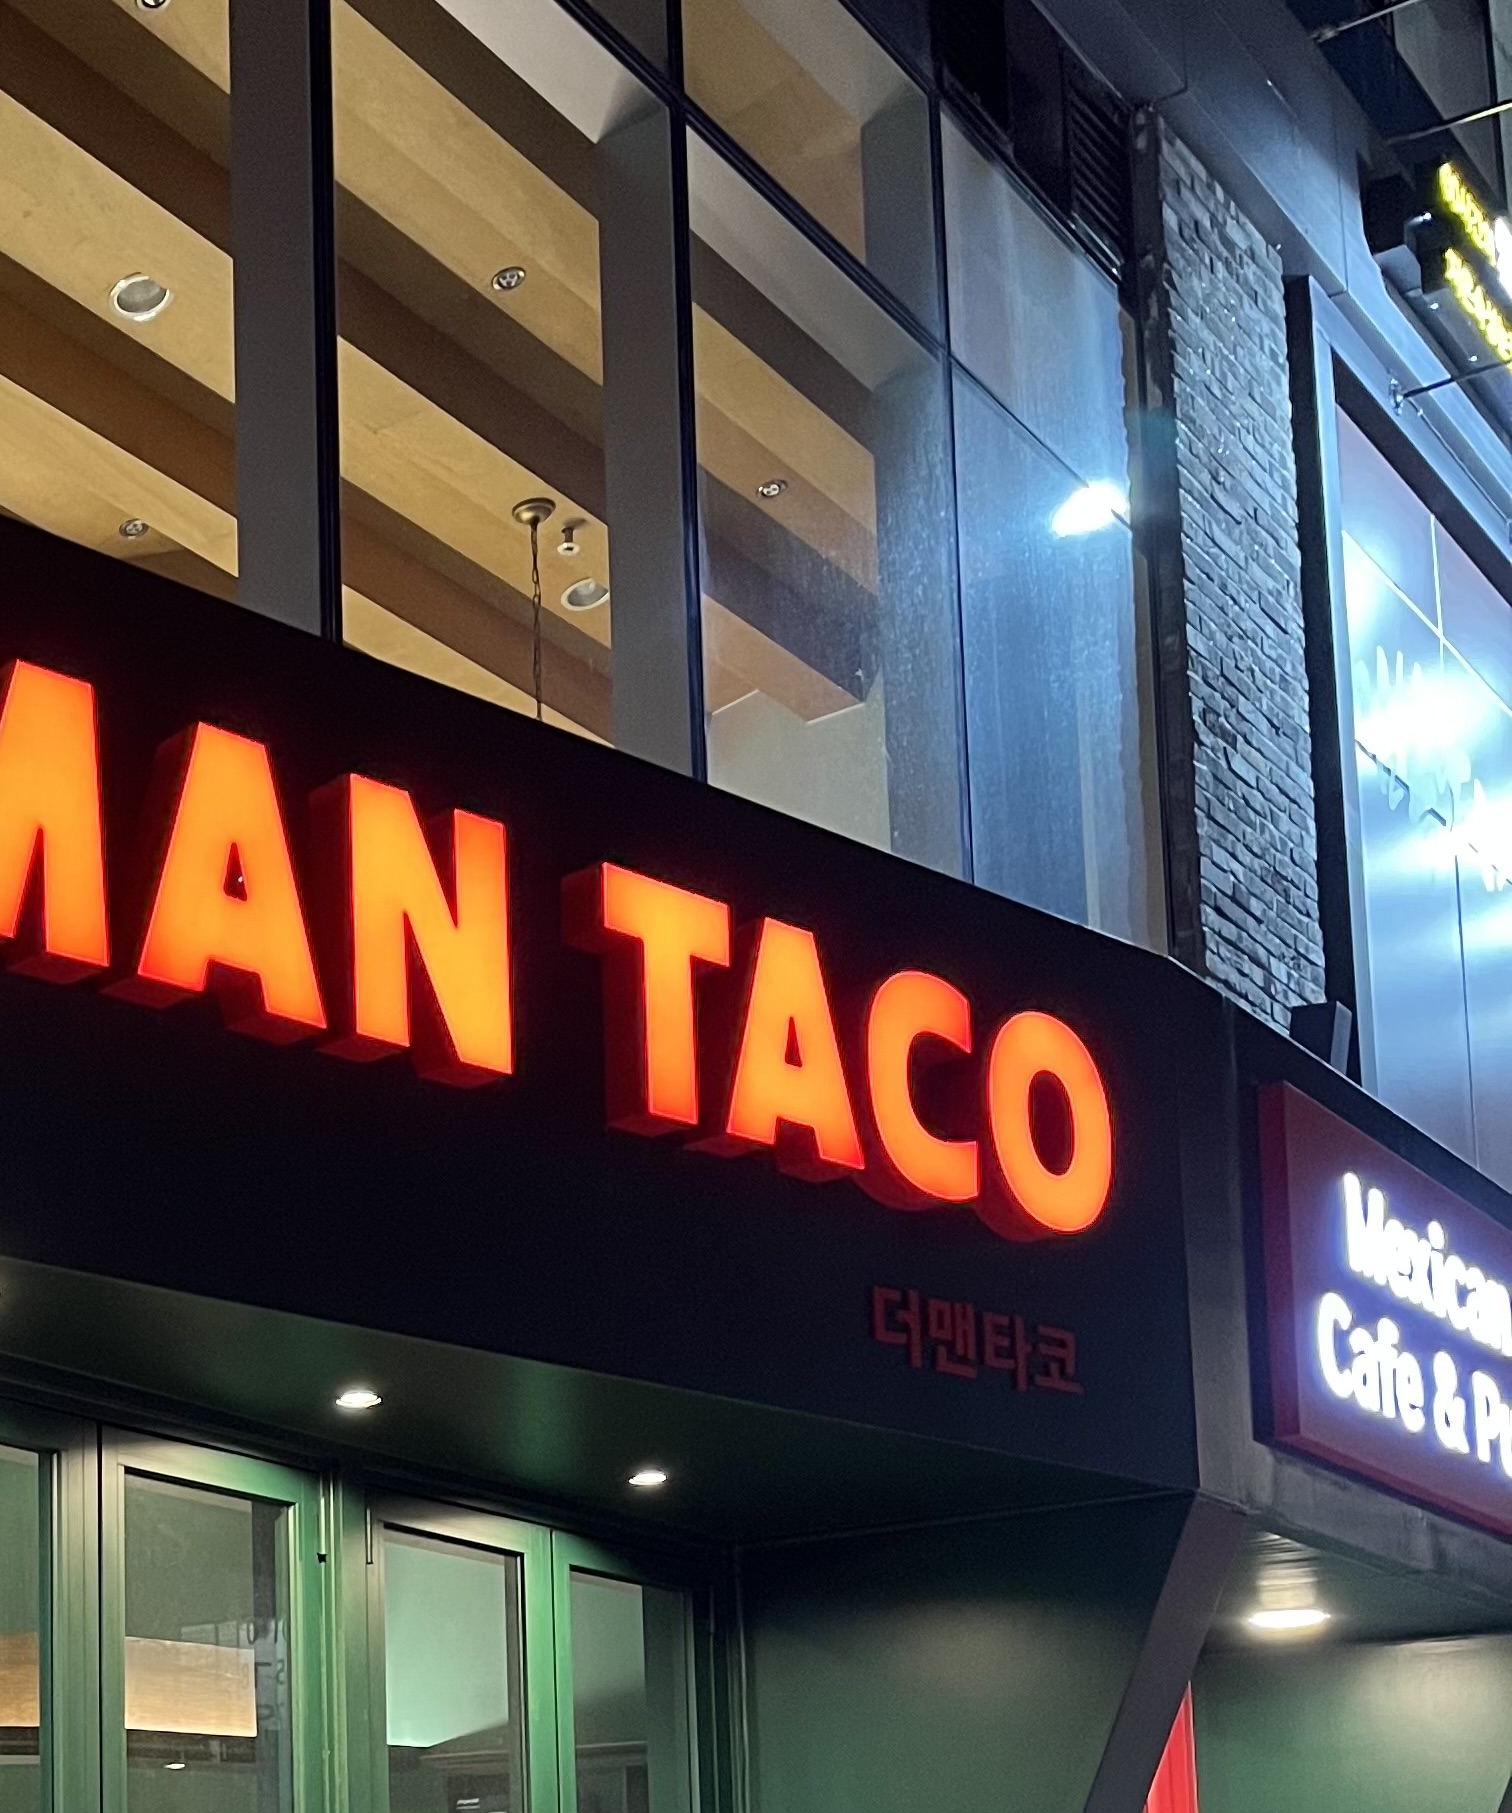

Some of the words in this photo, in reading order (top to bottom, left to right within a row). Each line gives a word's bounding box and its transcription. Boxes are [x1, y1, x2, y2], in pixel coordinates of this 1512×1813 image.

[600, 860, 1113, 1236] TACO
[870, 1284, 1084, 1395] 더맨타코
[1433, 1351, 1470, 1454] &
